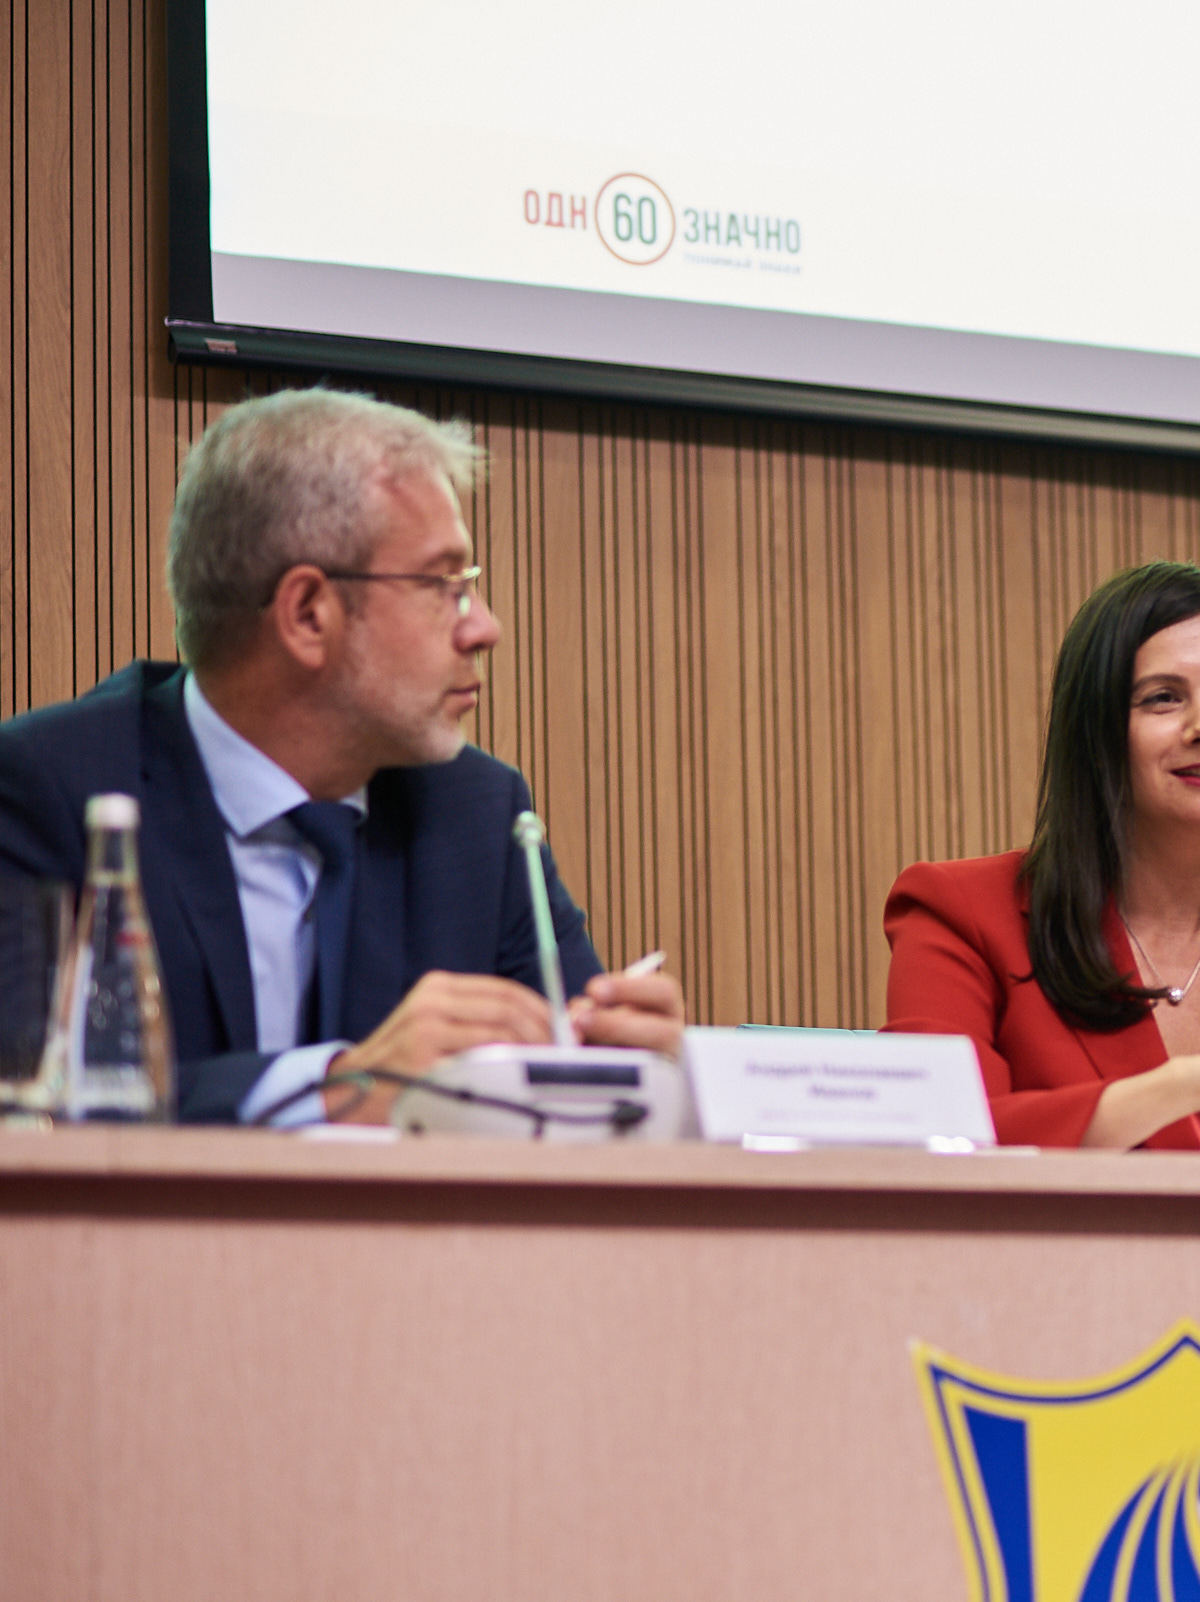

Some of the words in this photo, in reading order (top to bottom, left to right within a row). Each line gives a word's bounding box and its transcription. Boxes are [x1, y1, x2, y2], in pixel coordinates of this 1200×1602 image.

[523, 188, 588, 231] ОДН
[613, 192, 659, 246] 60
[682, 206, 802, 255] ЗНАЧНО
